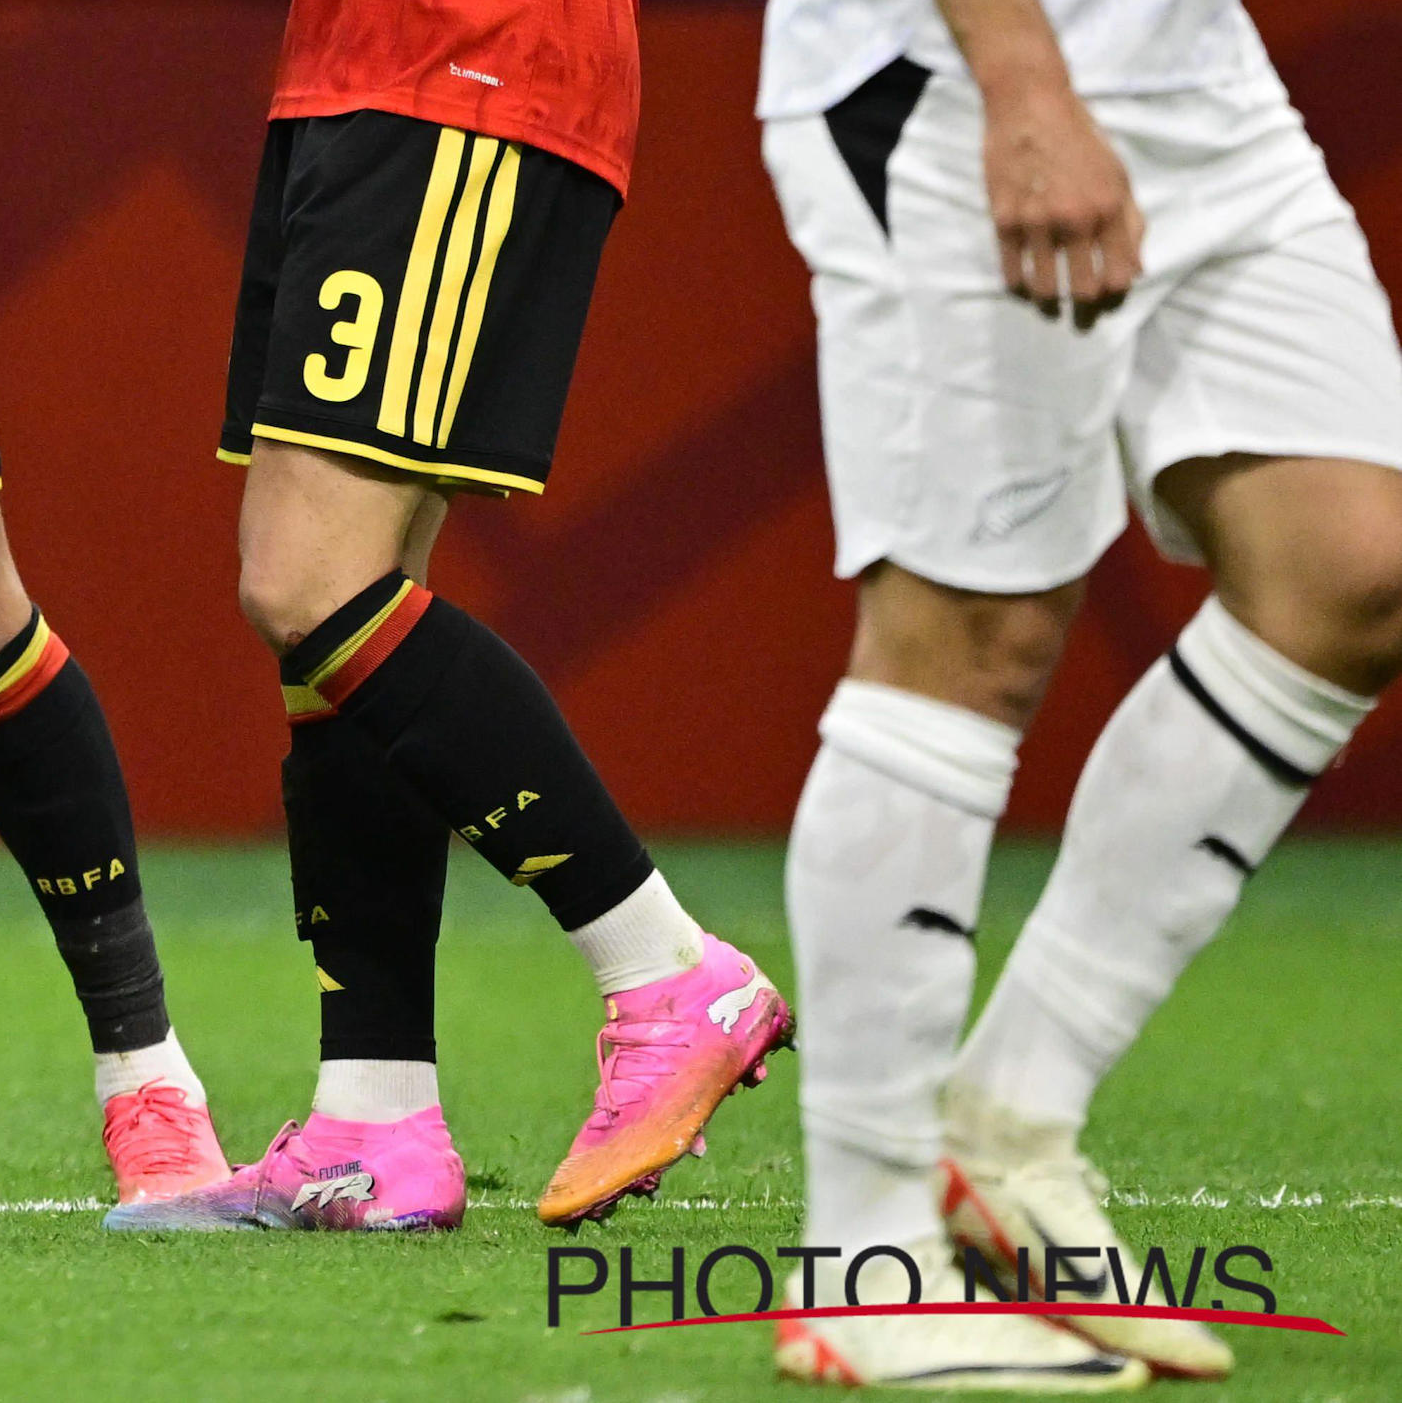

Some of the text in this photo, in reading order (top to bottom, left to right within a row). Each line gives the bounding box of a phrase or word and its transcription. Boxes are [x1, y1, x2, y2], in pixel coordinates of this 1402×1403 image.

[303, 269, 384, 402] 3
[37, 858, 125, 895] RBFA
[319, 1160, 362, 1179] FUTURE
